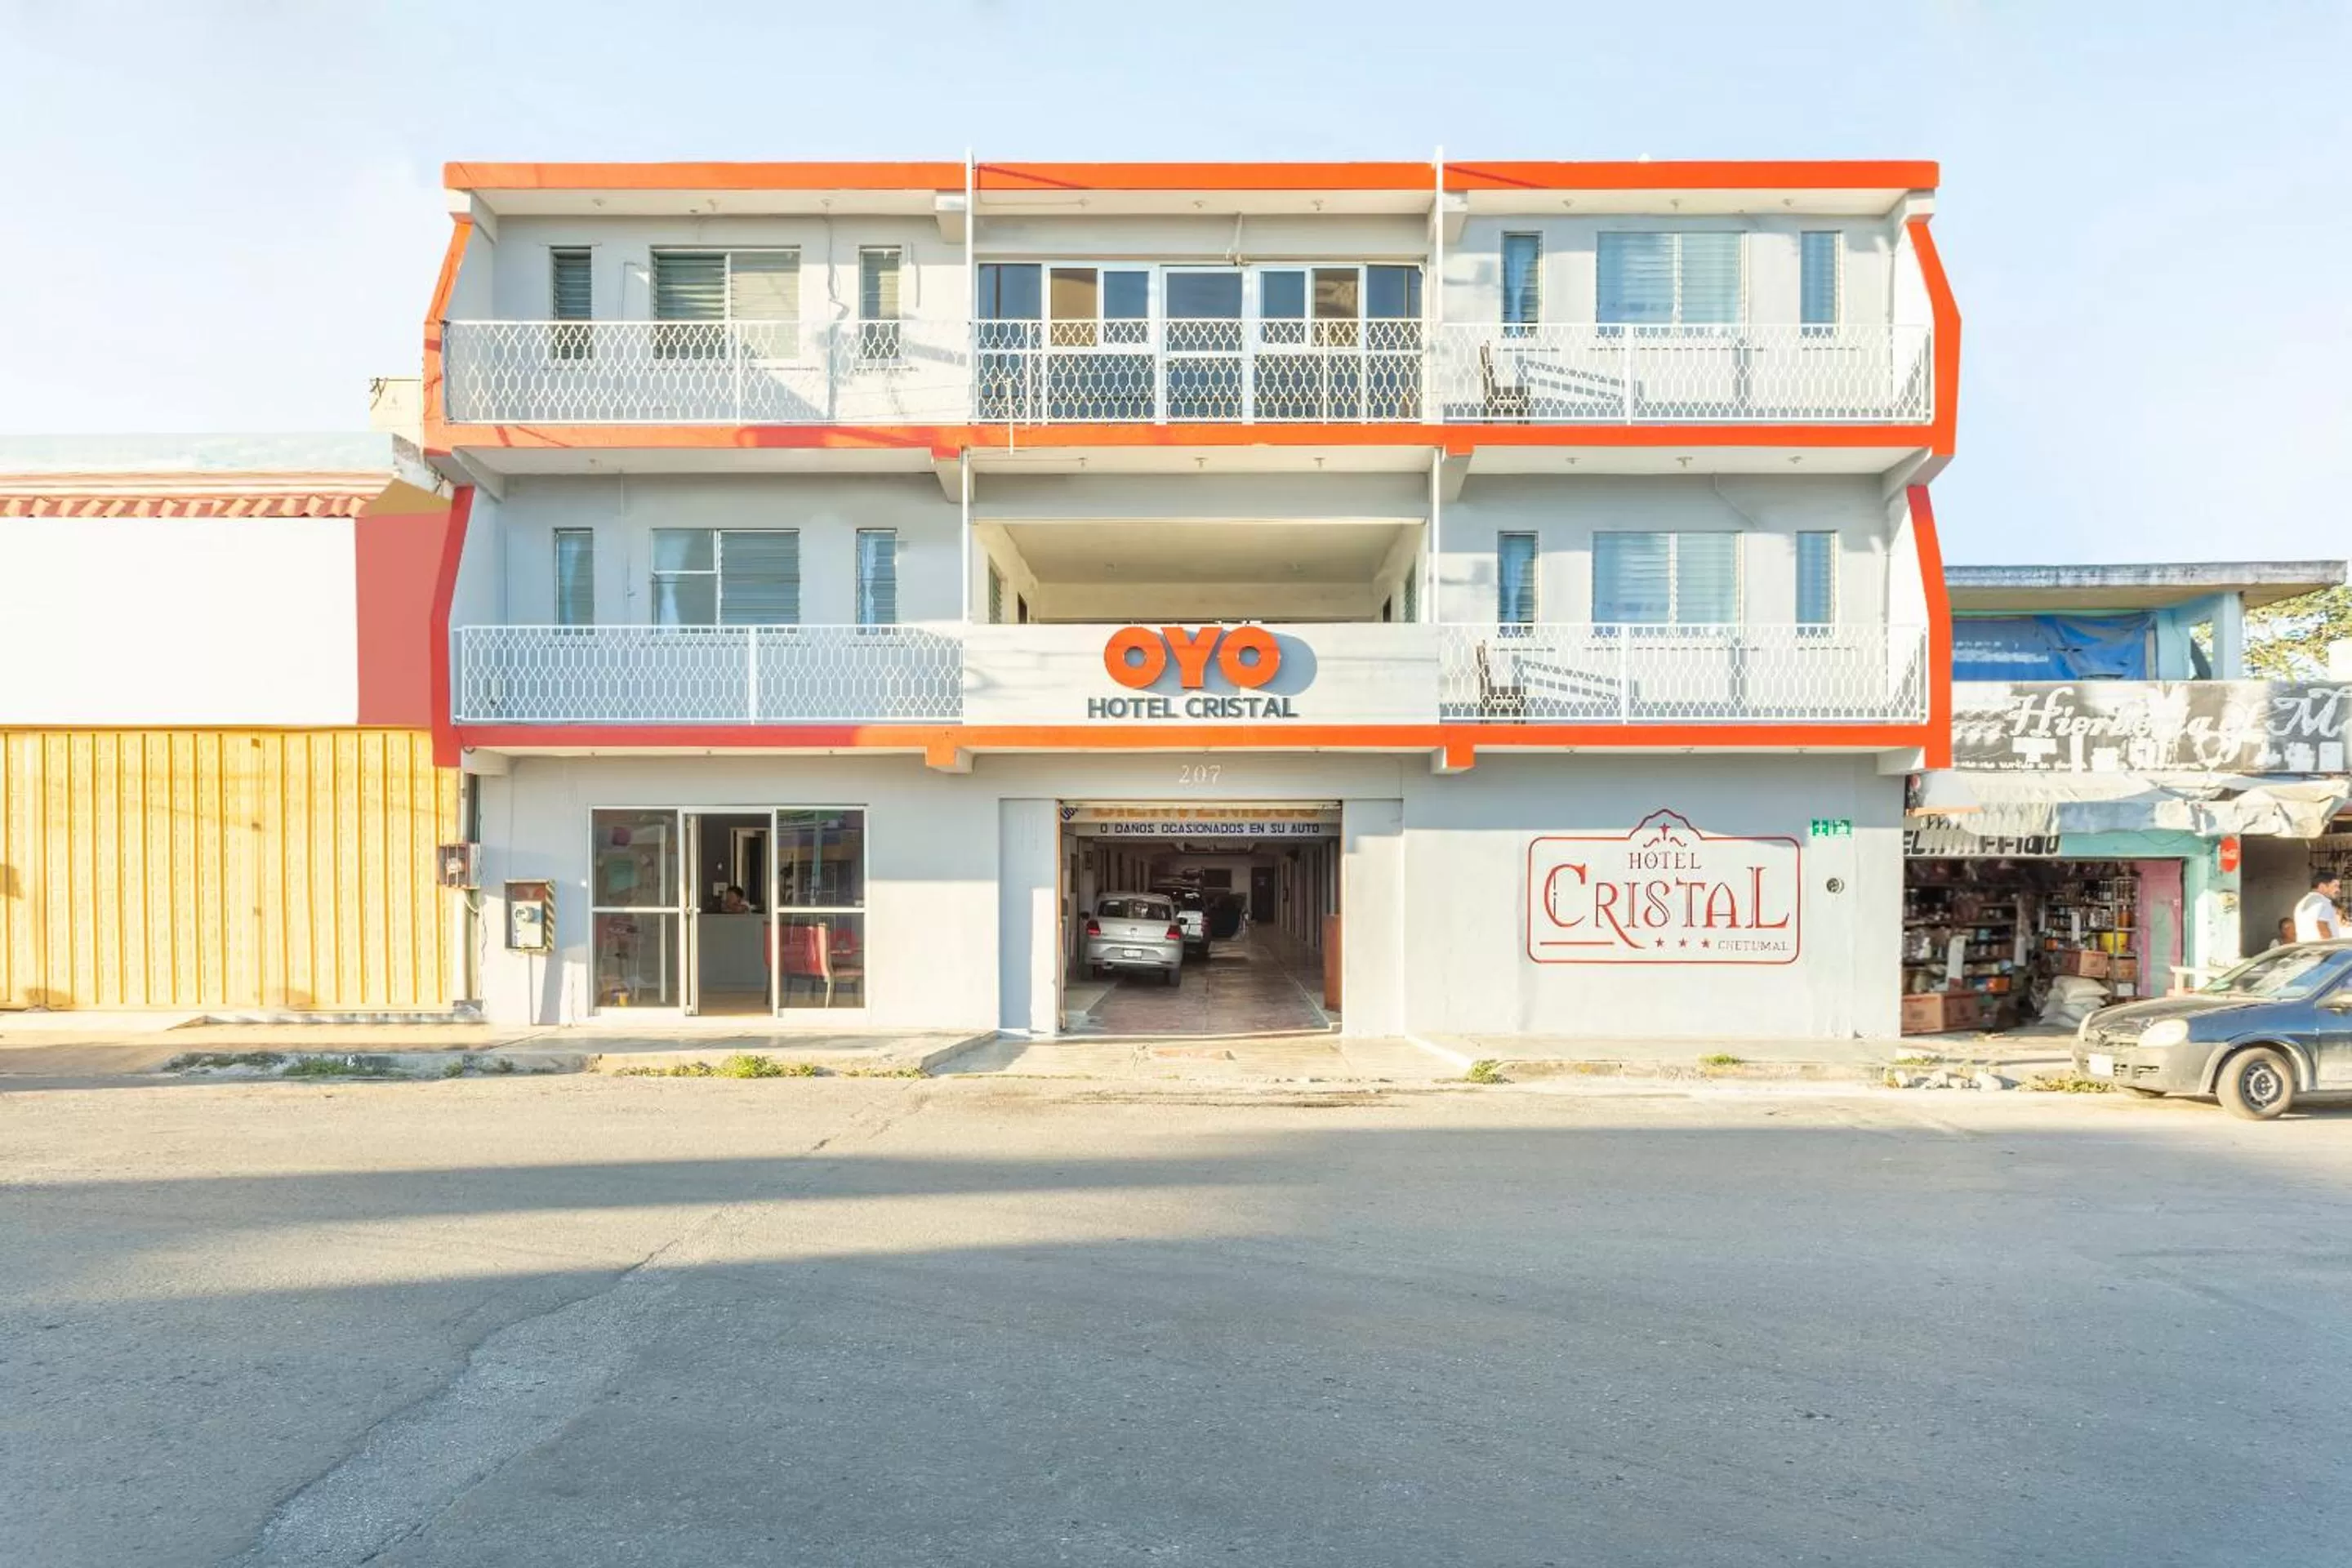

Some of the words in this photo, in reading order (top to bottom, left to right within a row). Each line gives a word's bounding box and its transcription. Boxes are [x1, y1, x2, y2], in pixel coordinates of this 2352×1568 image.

[1103, 626, 1281, 689] OYO
[1088, 697, 1179, 719] HOTEL
[1185, 697, 1299, 719] CRISTAL
[2266, 686, 2352, 737] M
[1178, 764, 1222, 785] 207
[1161, 823, 1245, 834] OCASIONADOS
[1250, 823, 1265, 834] EN
[1270, 823, 1285, 834] SU
[1291, 823, 1320, 834] AUTO
[1629, 852, 1702, 870] HOTEL
[1544, 863, 1790, 949] CRISTAL
[1717, 940, 1789, 951] CHETUMAL
